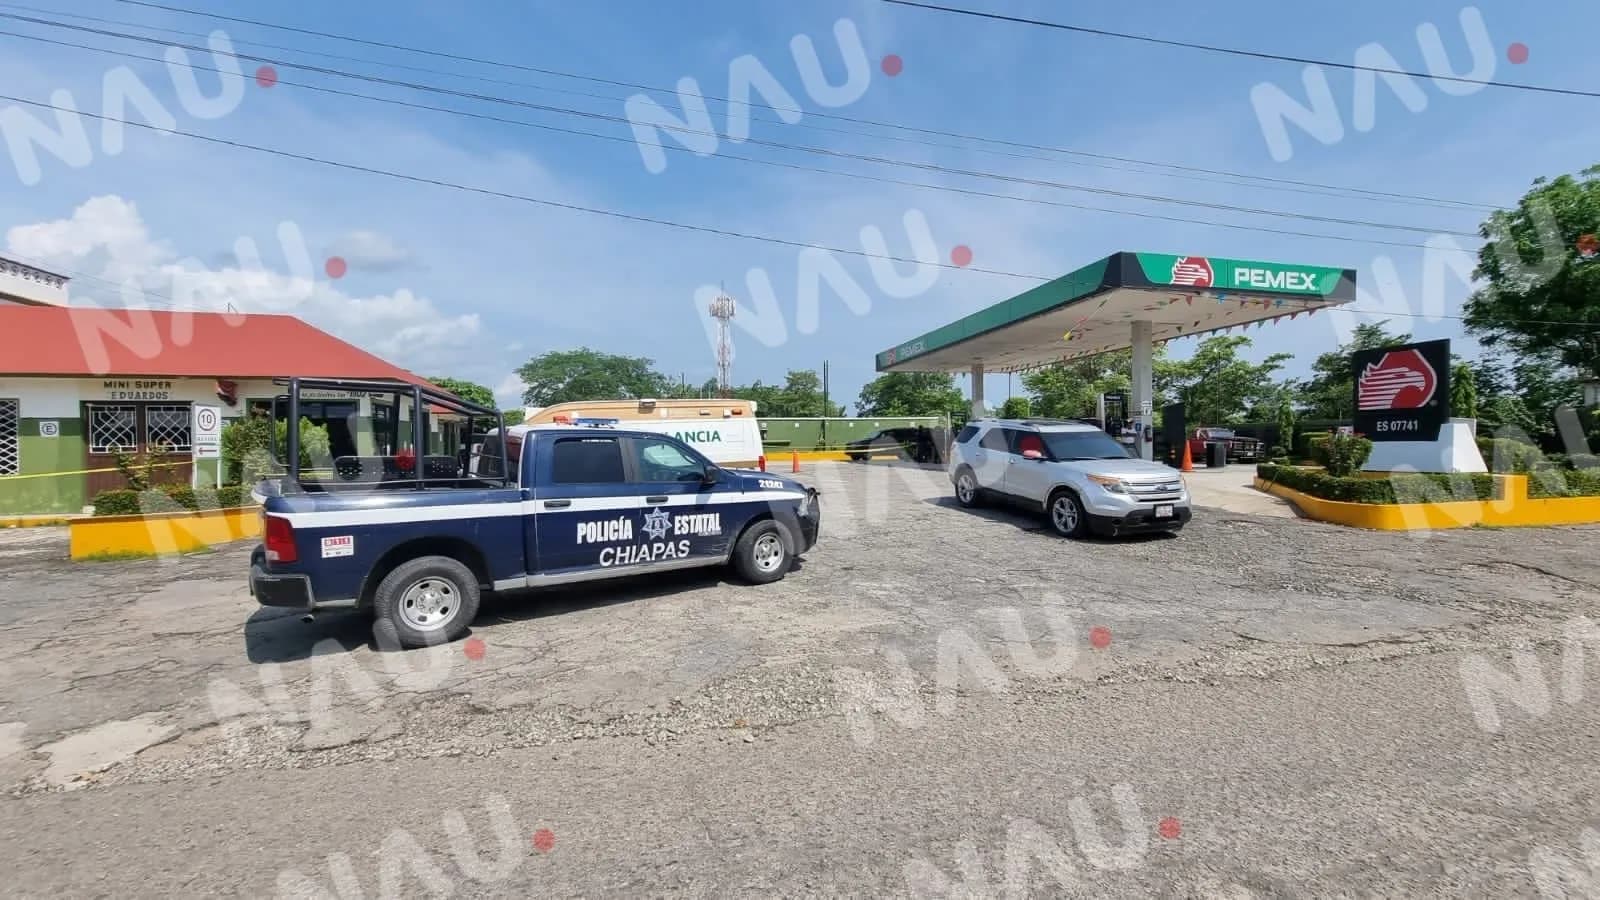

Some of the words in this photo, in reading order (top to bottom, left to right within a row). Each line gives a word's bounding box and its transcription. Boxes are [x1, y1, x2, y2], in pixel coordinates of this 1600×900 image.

[1234, 267, 1317, 291] PEMEX
[103, 380, 129, 389] MINI
[135, 380, 171, 389] SUPER
[111, 391, 169, 400] EDUARDOS
[201, 413, 213, 425] 10
[1376, 421, 1389, 432] ES
[1390, 419, 1419, 431] 07741
[576, 515, 633, 544] POLICÍA
[674, 512, 721, 535] ESTATAL
[599, 539, 691, 567] CHIAPAS
